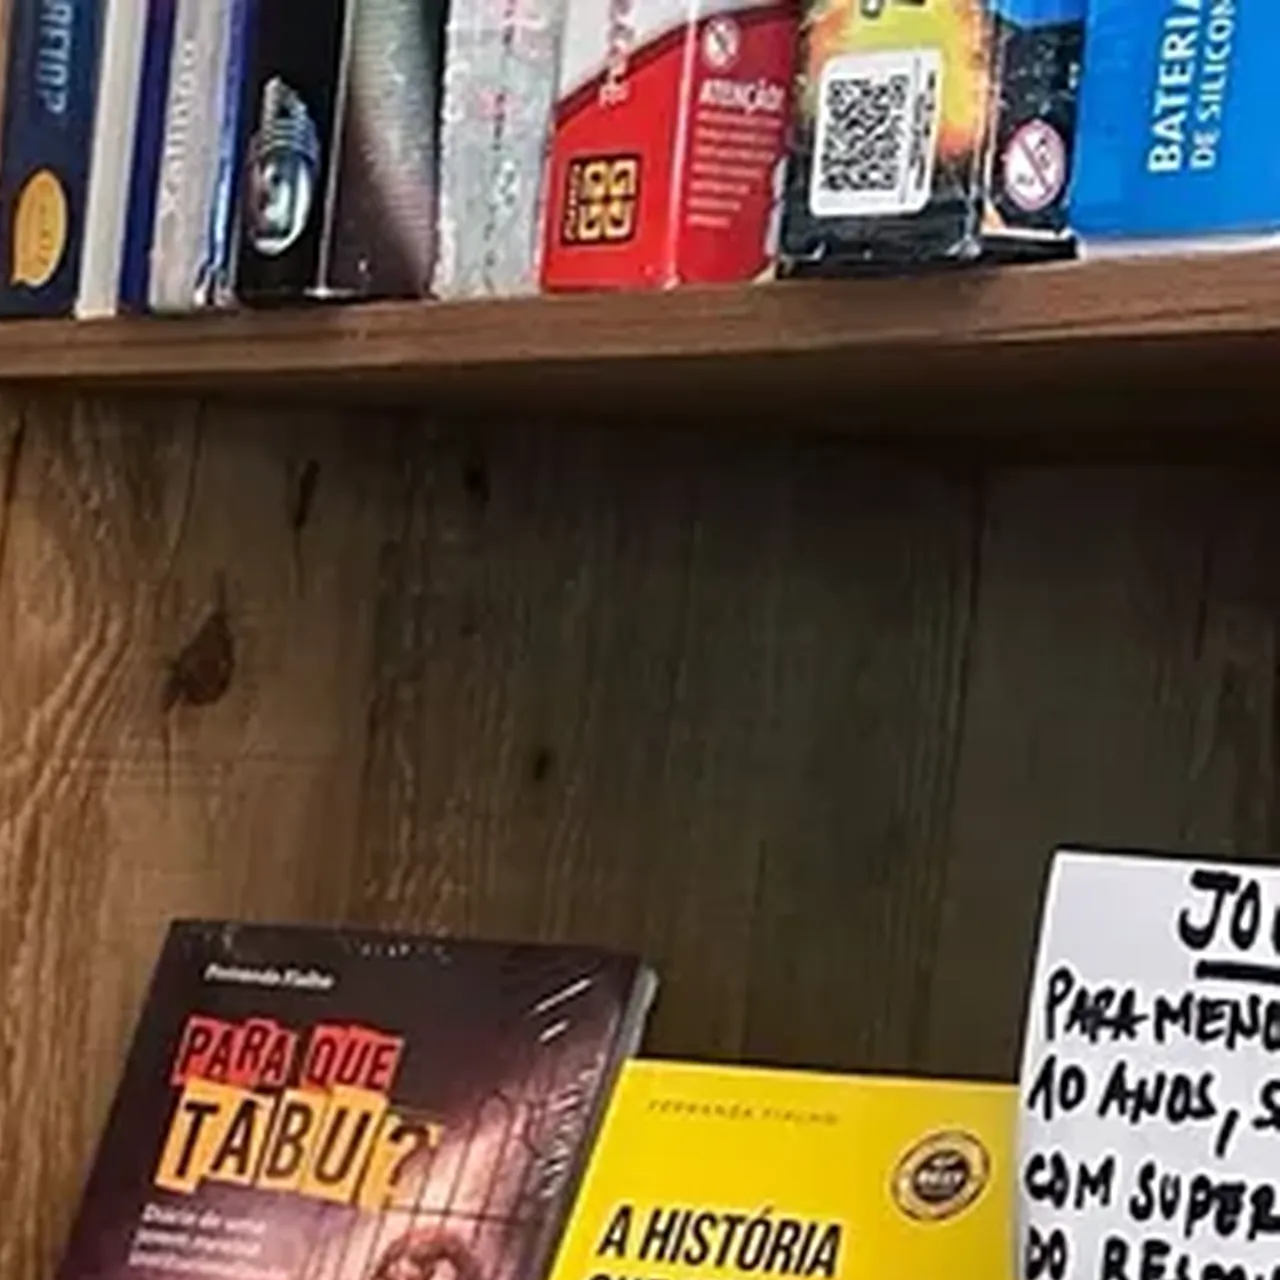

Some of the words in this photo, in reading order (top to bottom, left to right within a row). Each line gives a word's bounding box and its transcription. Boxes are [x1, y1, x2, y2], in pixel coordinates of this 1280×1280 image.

[1190, 128, 1220, 169] DE
[1177, 868, 1280, 951] JO
[178, 1023, 285, 1080] PARA
[308, 1035, 396, 1092] QUE
[1027, 1054, 1084, 1122] 10
[1024, 1152, 1115, 1210] COM
[596, 1204, 634, 1261] A
[638, 1206, 843, 1280] HISTÓRIA
